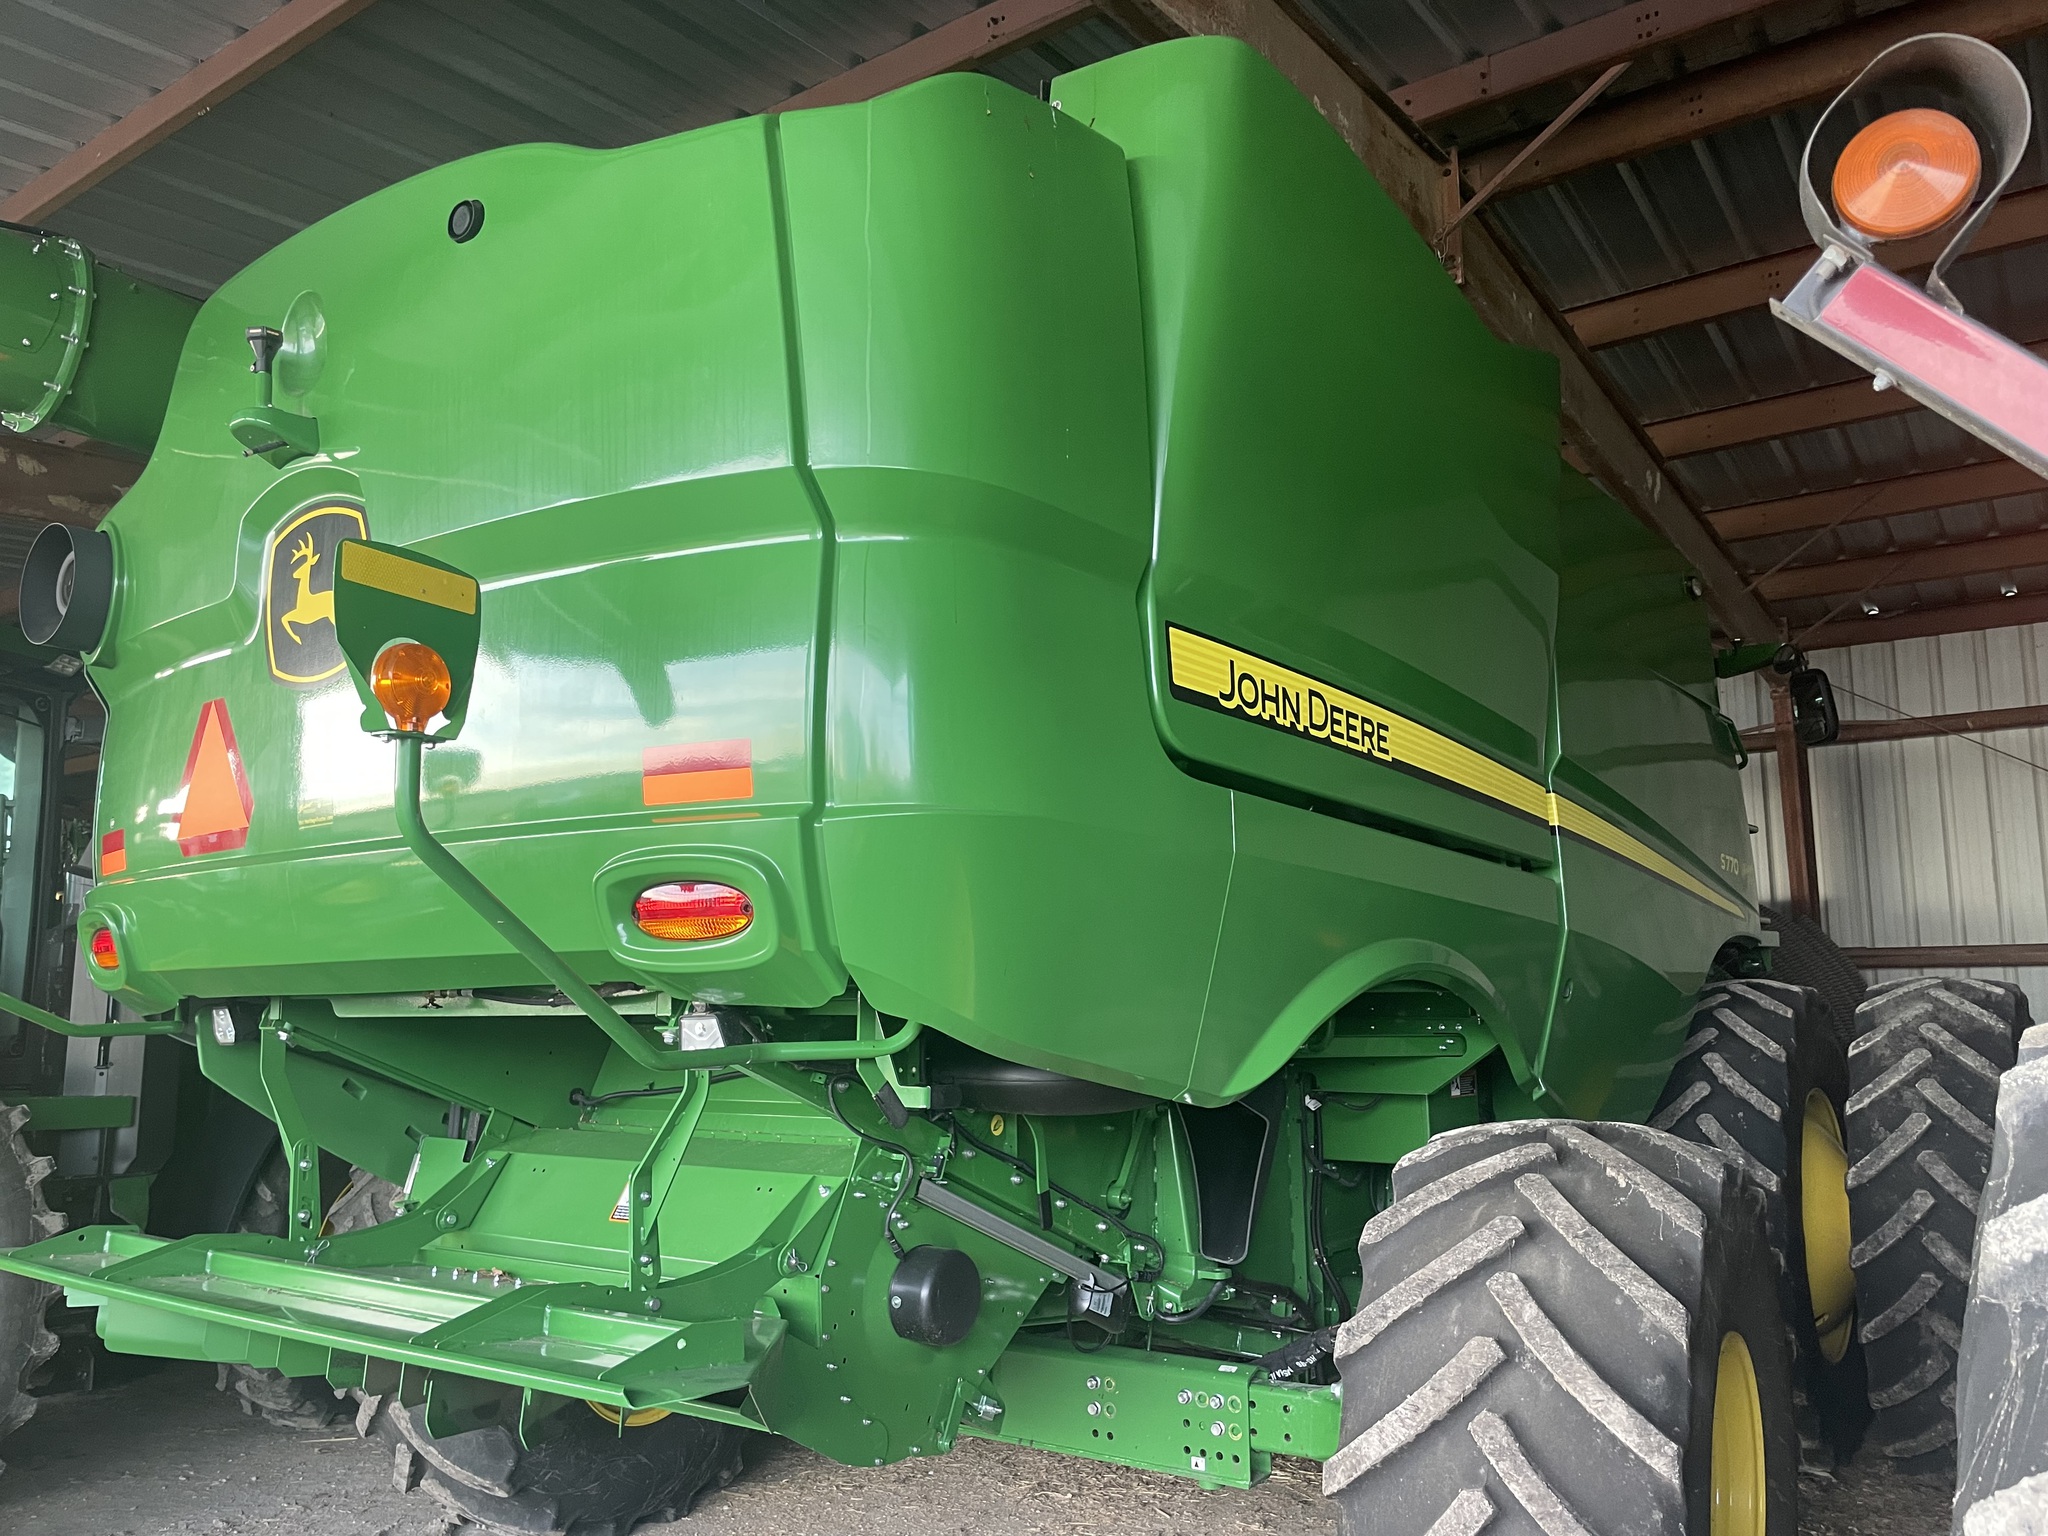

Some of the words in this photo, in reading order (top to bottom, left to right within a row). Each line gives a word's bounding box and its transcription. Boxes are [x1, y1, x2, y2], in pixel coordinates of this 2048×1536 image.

[1219, 659, 1301, 727] JOHN
[1307, 687, 1391, 758] DEERE
[1720, 853, 1739, 875] S770
